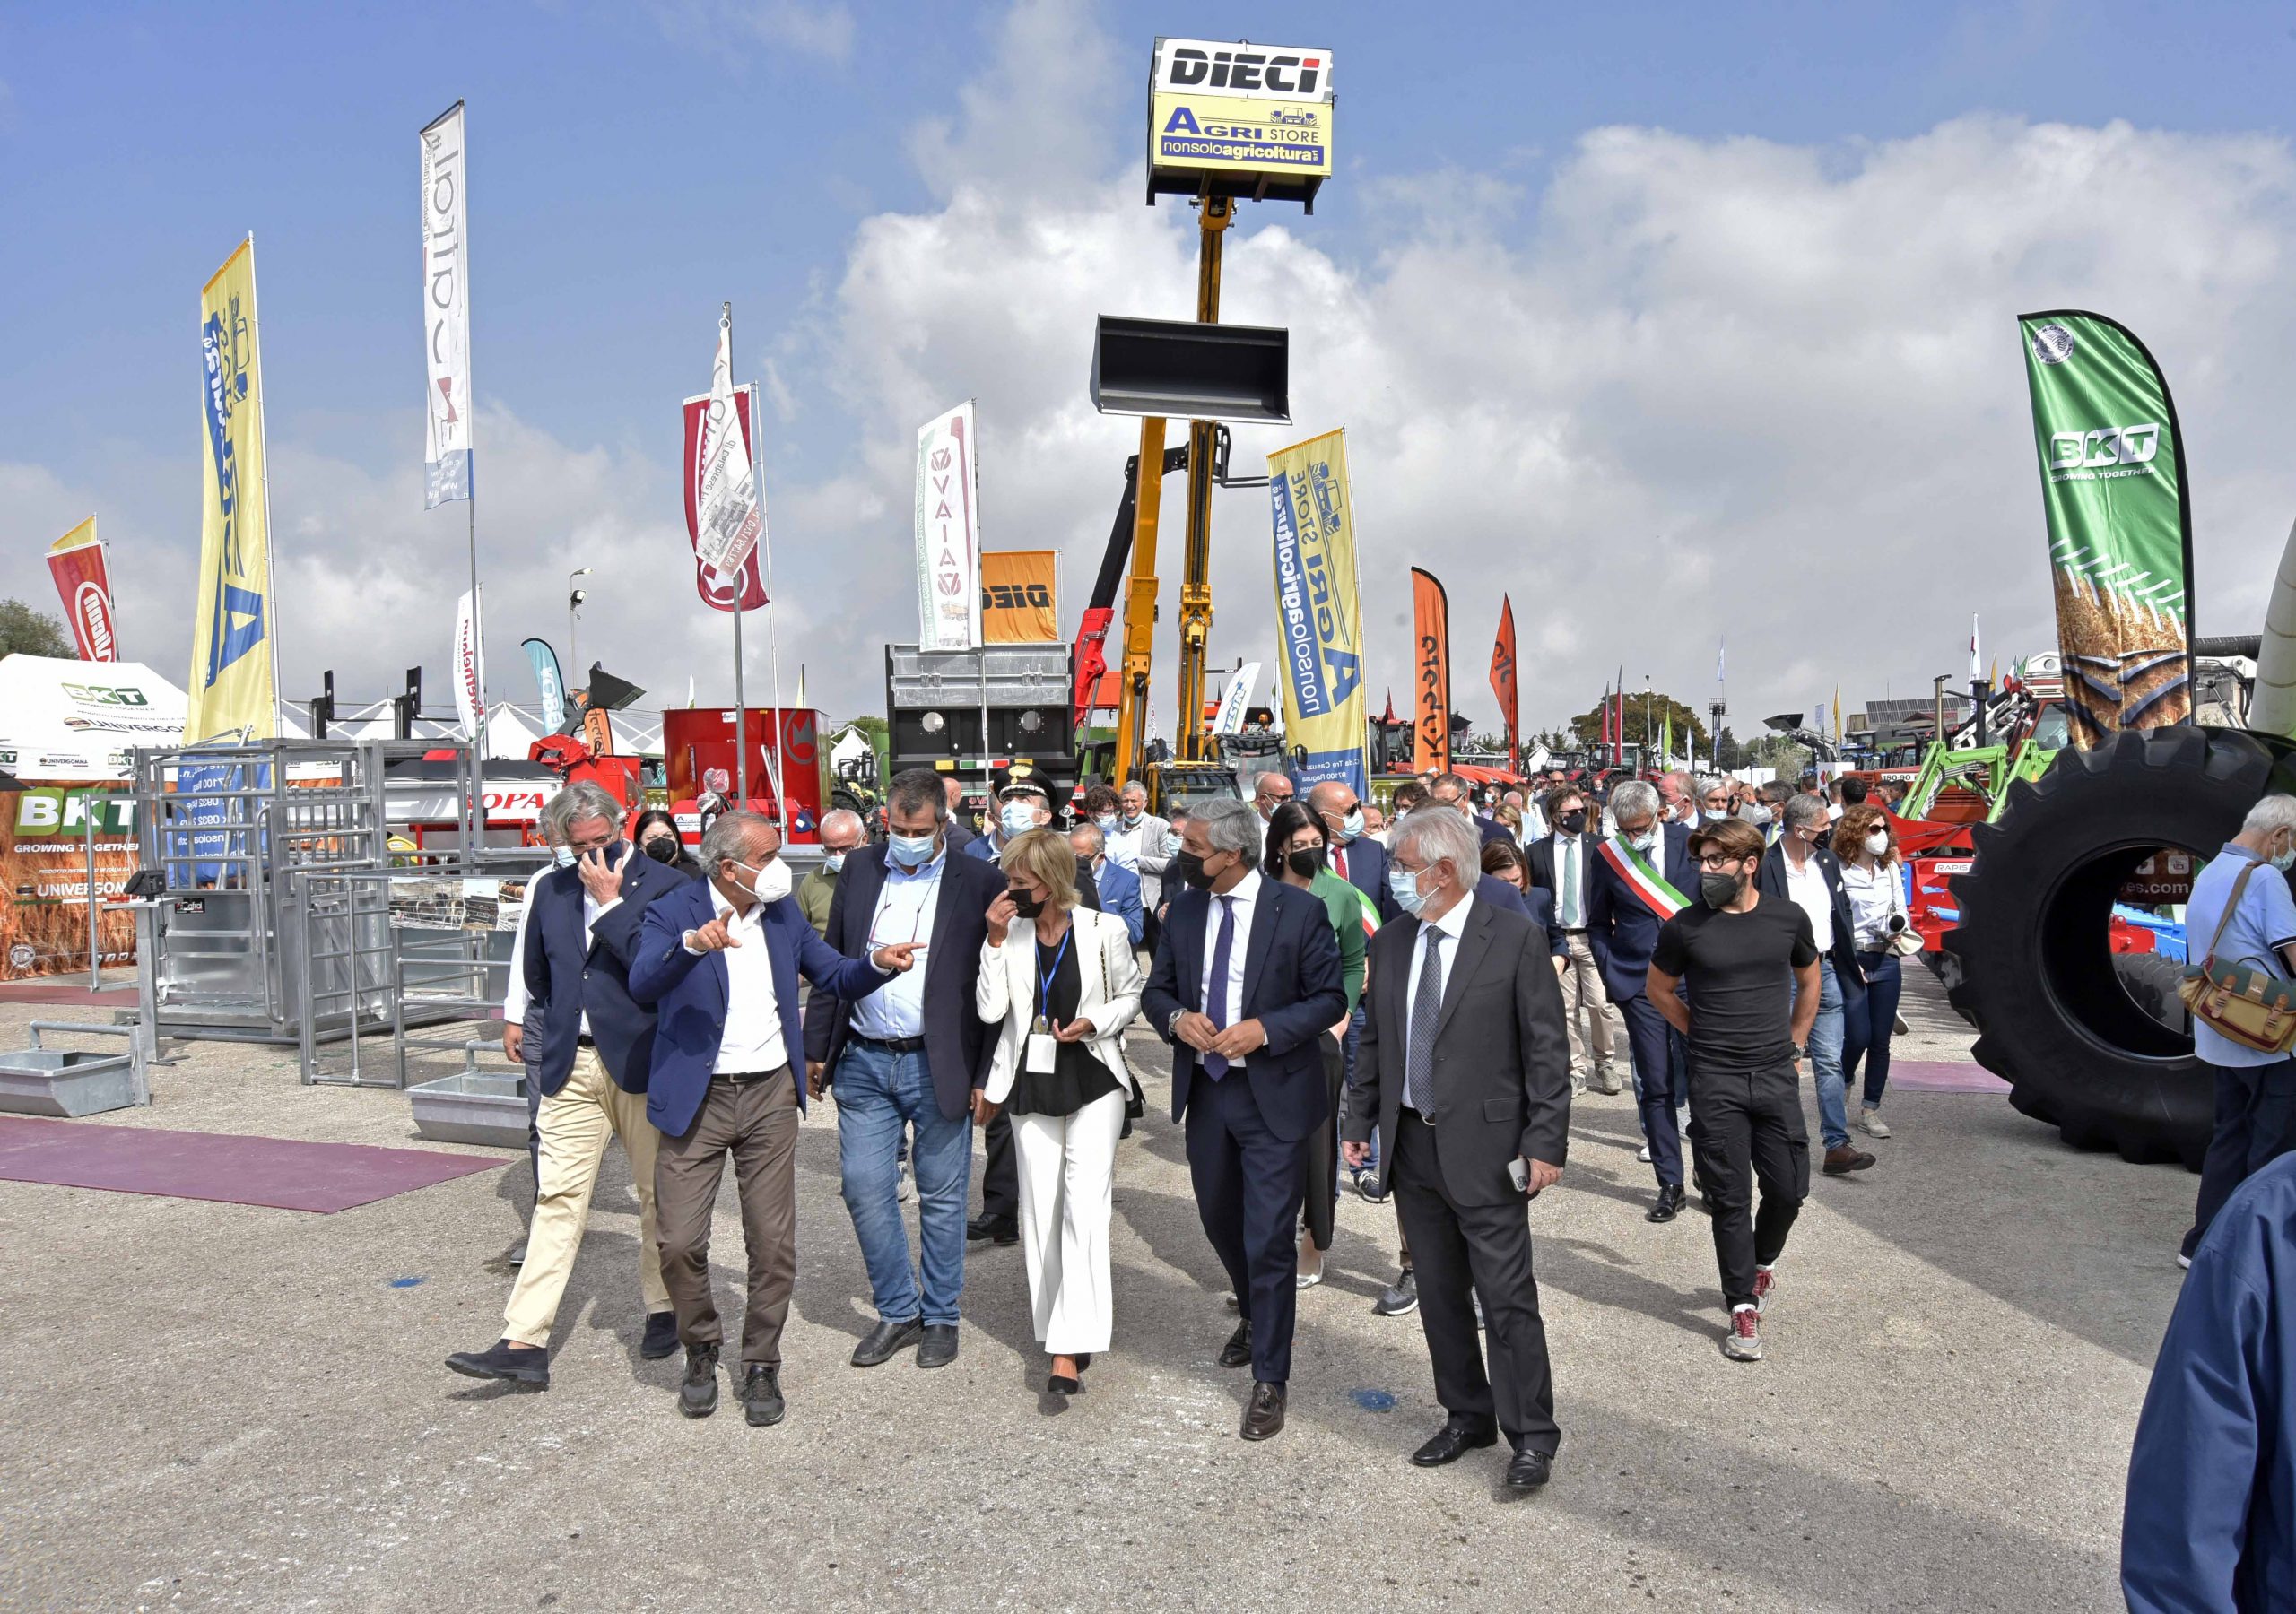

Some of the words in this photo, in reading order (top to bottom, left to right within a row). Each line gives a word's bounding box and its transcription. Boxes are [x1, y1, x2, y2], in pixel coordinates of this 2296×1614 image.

[1170, 48, 1320, 94] DIECI
[1163, 107, 1262, 140] AGRI
[1270, 128, 1318, 143] STORE
[1163, 140, 1312, 162] nonsoloagricoltura
[2052, 428, 2156, 465] BKT
[2050, 473, 2096, 483] GROWING
[2098, 467, 2156, 480] TOGETHER
[62, 682, 148, 706] BKT
[89, 719, 185, 733] UNIVERGO
[19, 795, 137, 827] BKT
[466, 793, 544, 810] OPA
[14, 844, 74, 853] GROWING
[79, 843, 139, 852] TGETHE
